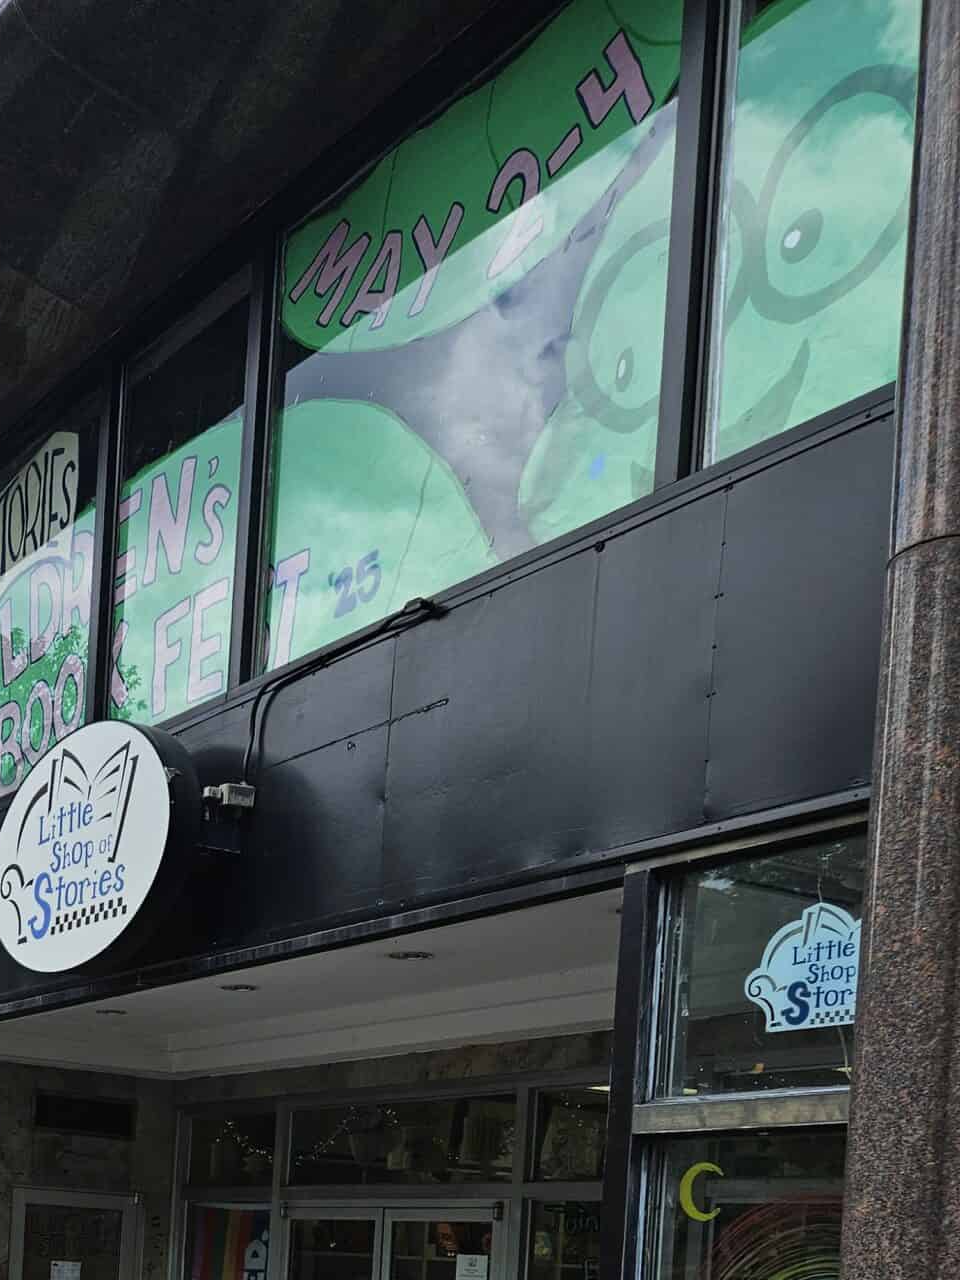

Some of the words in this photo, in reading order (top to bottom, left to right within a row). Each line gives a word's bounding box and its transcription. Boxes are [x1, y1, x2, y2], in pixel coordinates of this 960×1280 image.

[289, 201, 464, 332] MAY
[486, 28, 654, 279] 2-4
[151, 547, 311, 718] FET
[327, 549, 382, 618] '25
[38, 800, 94, 846] Little
[50, 840, 94, 873] Shop
[98, 834, 113, 854] of
[27, 863, 126, 939] Stories
[791, 938, 856, 967] Little
[806, 963, 856, 985] Shop
[780, 981, 854, 1026] Stor
